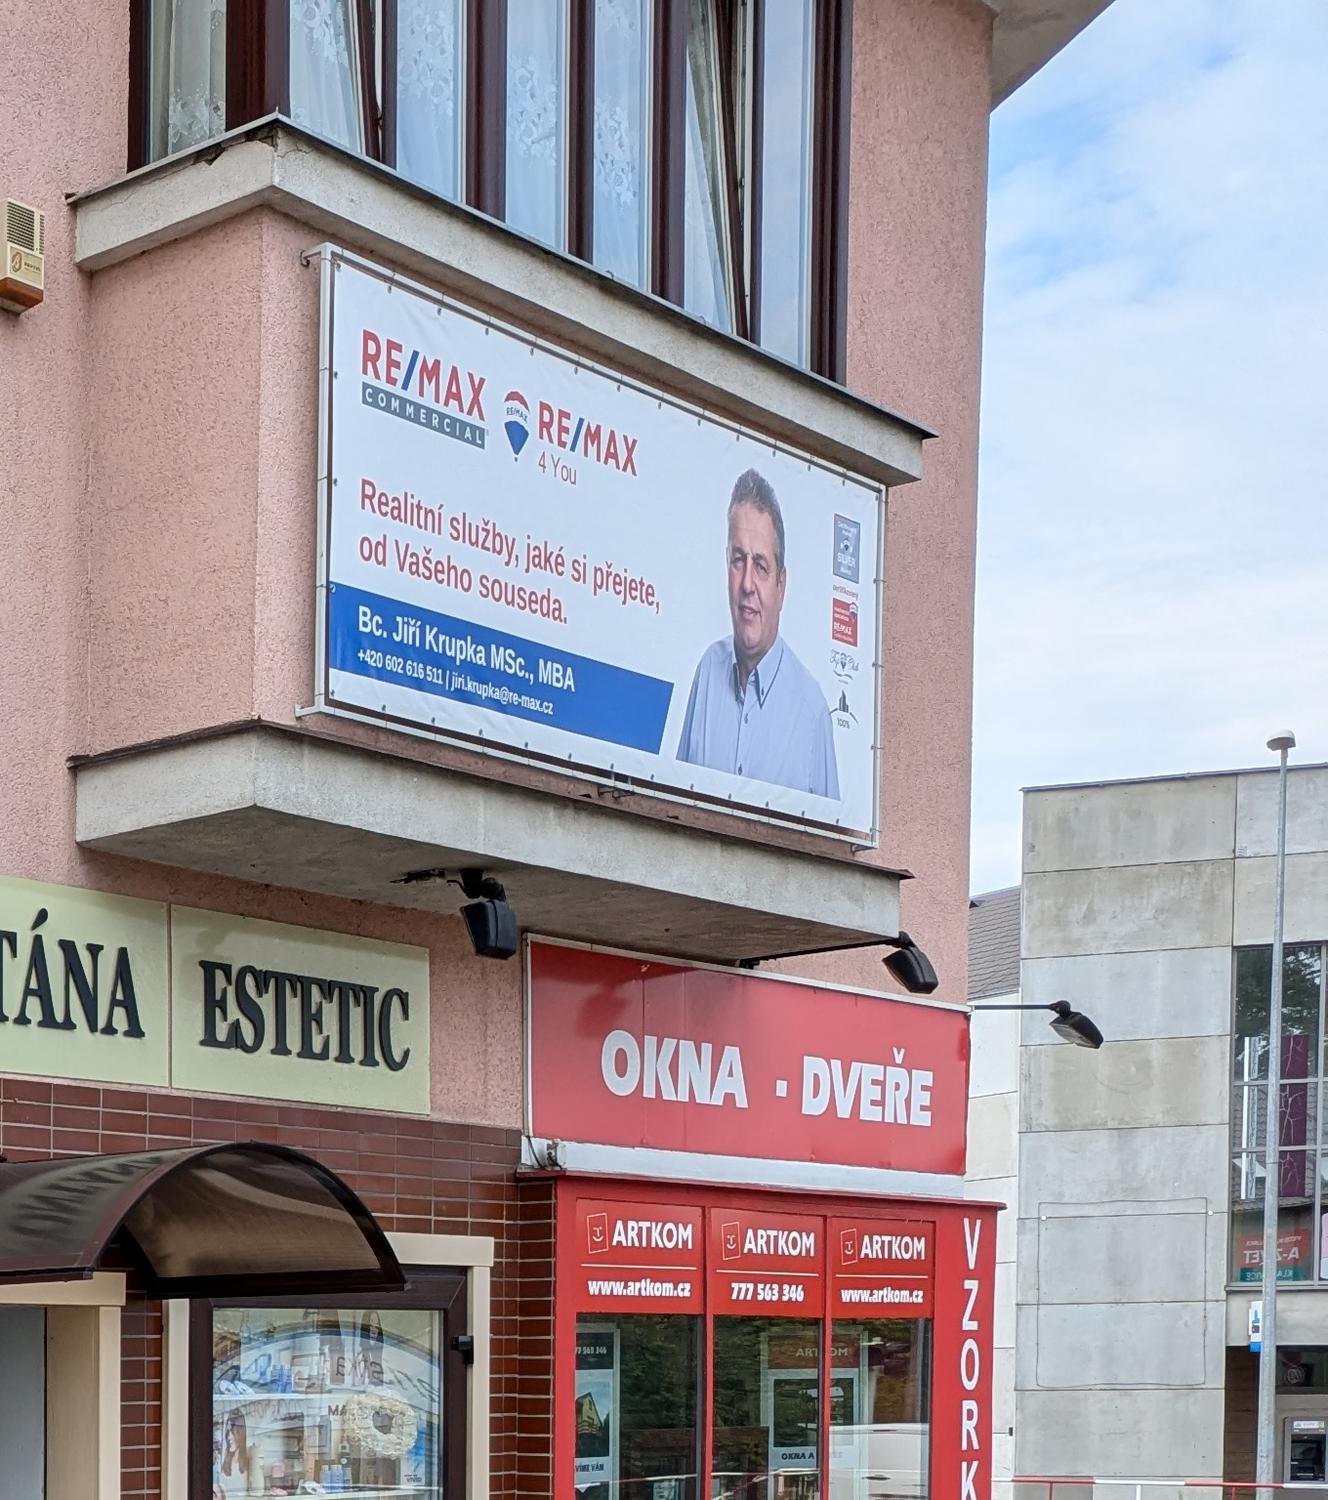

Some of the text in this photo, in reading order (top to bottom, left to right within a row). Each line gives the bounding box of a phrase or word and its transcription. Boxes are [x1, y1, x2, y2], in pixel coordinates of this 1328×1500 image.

[362, 329, 486, 422] RE/MAX
[365, 387, 483, 446] COMMERCIAL
[538, 400, 638, 477] RE/MAX
[538, 451, 577, 486] 4 You
[360, 478, 661, 615] Realitní služby, jaké si přejete,
[359, 533, 568, 625] od Vašeho souseda.
[358, 605, 576, 693] Bc. Jiří Krupka MSc., MBA
[357, 648, 383, 668] +420
[385, 655, 404, 674] 602
[406, 662, 425, 681] 616
[426, 668, 444, 686] 511
[451, 670, 554, 716] jiri.krupka@re-max.cz
[197, 958, 411, 1073] ESTETIC
[600, 1029, 934, 1127] OKNA DVEŘE
[612, 1219, 693, 1250] ARTKOM
[744, 1228, 815, 1257] ARTKOM
[859, 1235, 926, 1261] ARTKOM
[587, 1278, 691, 1297] www.artkom.cz
[731, 1282, 804, 1302] 777 563 346
[840, 1286, 924, 1303] www.artkom.cz
[796, 1347, 849, 1357] ARTOM
